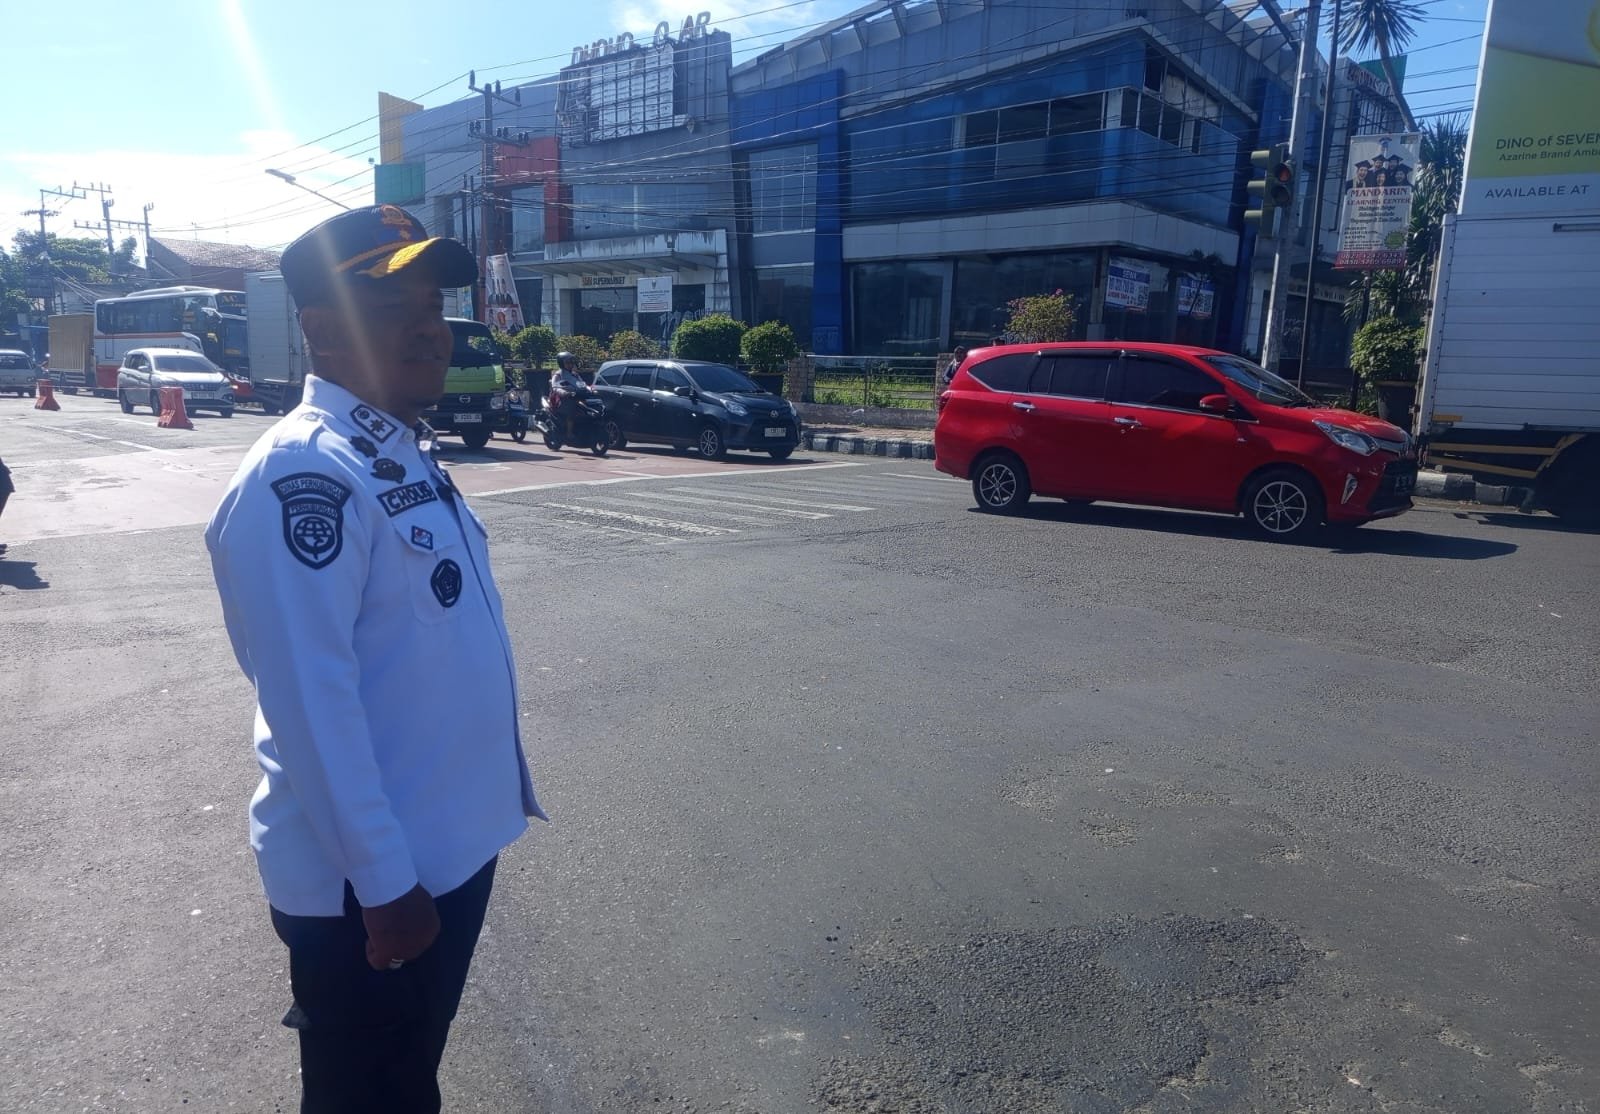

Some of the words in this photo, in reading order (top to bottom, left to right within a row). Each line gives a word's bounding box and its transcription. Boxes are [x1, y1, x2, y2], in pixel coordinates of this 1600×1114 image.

[1496, 137, 1534, 149] DINO
[1538, 136, 1553, 147] of
[1499, 152, 1537, 161] Azarine
[1540, 150, 1570, 159] Brand
[1350, 188, 1407, 198] MANDARIN
[1485, 185, 1566, 199] AVAILABLE
[1570, 184, 1590, 195] AT
[593, 276, 625, 285] SUPERMARKET
